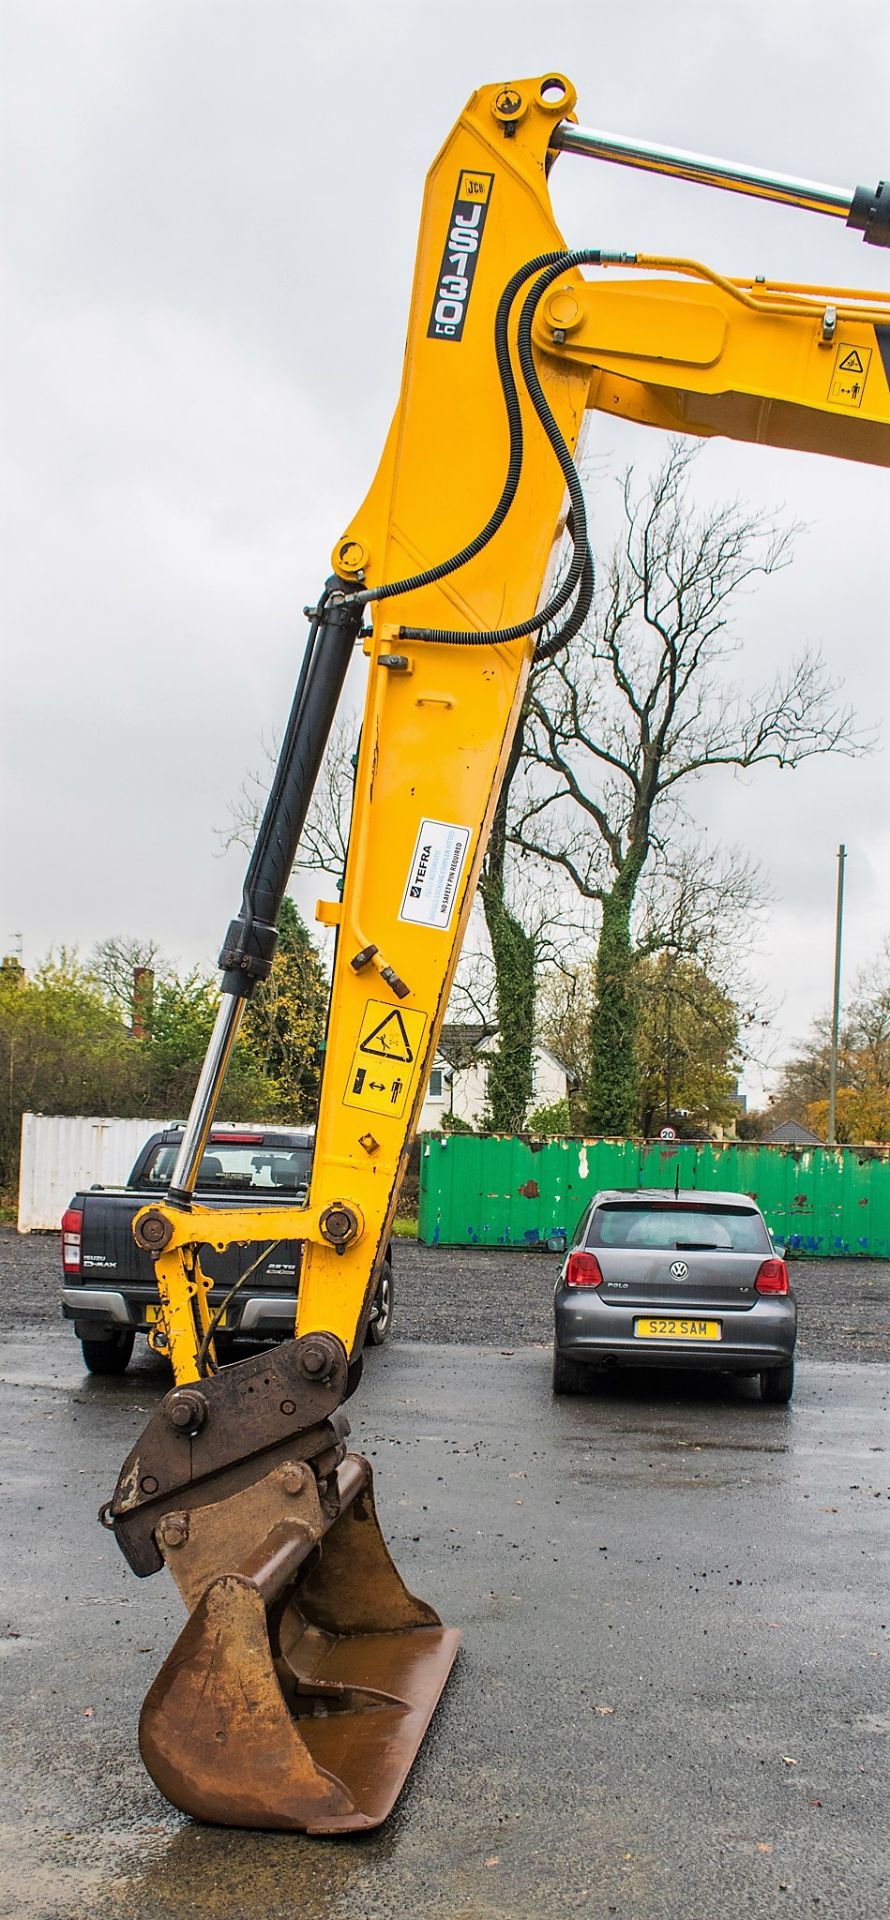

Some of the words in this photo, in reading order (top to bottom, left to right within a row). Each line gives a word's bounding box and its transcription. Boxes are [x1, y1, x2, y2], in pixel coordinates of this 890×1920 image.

[468, 181, 484, 194] JCB
[434, 204, 482, 326] JS130
[435, 324, 456, 335] LC
[450, 842, 462, 872] REQUIRED
[415, 844, 432, 885] TEFRA
[447, 872, 455, 883] PIN
[442, 883, 452, 904] SAFETY
[440, 904, 447, 913] NO
[662, 1131, 673, 1139] 20
[649, 1321, 676, 1334] S22
[680, 1322, 707, 1335] SAM
